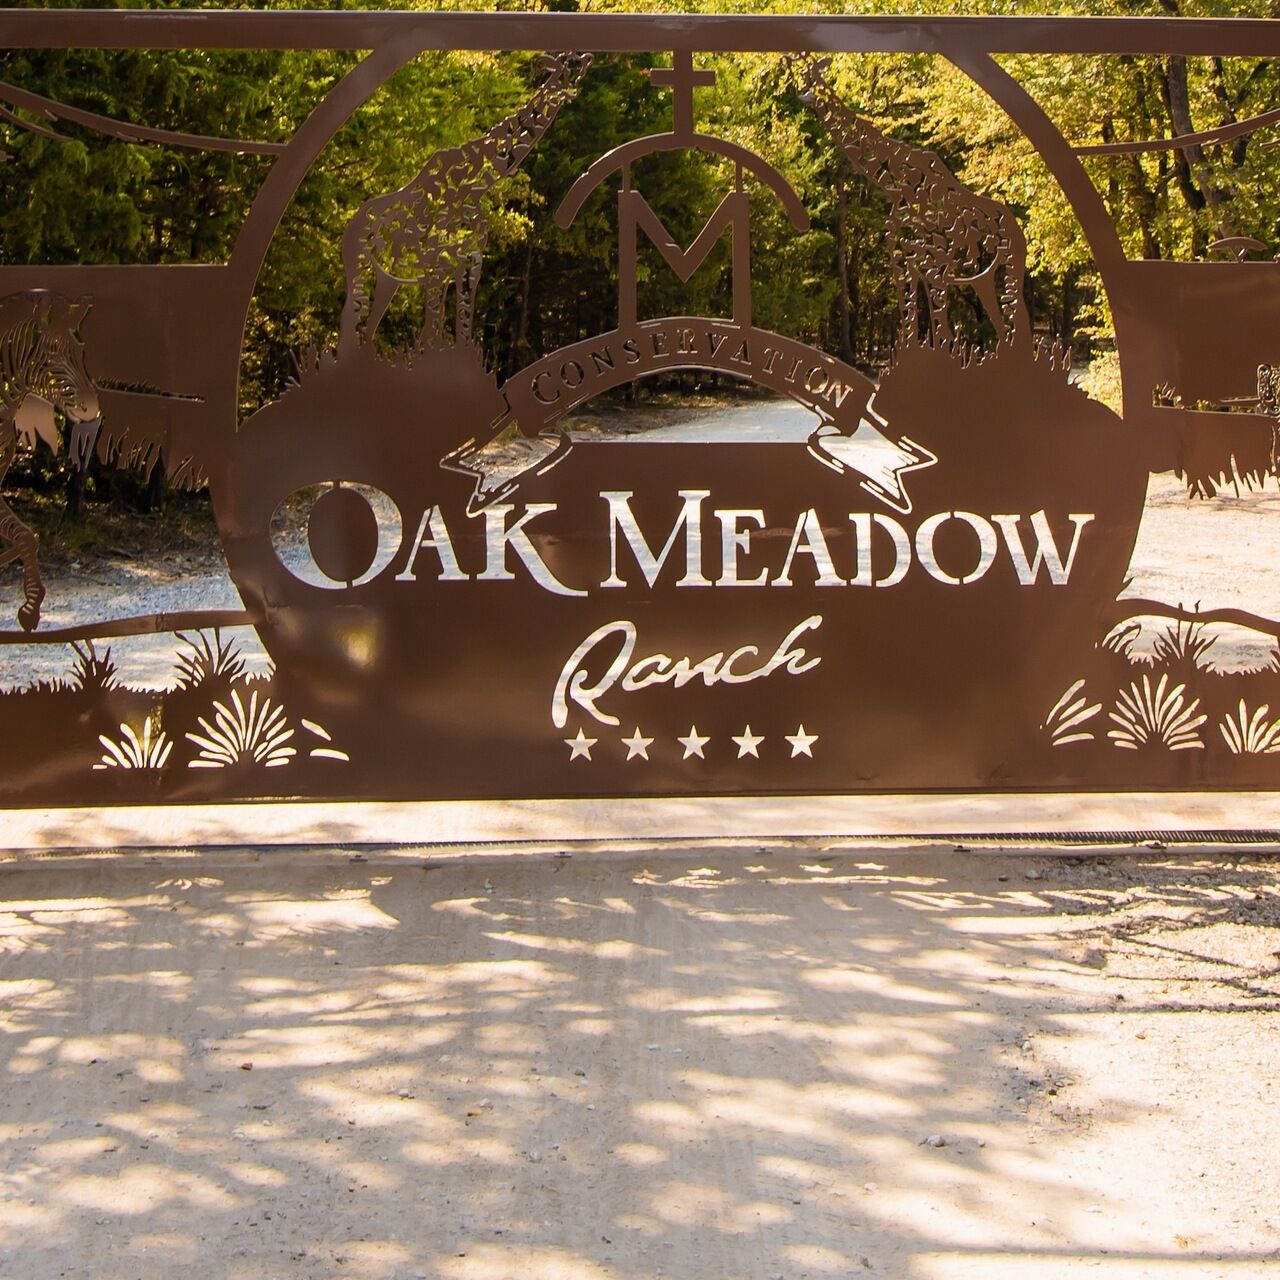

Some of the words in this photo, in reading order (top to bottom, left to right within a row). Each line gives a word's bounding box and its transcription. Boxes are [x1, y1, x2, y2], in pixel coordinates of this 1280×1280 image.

[618, 189, 751, 326] M
[531, 326, 853, 409] CONSERVATION
[269, 480, 589, 597] OAK
[600, 489, 1096, 588] MEADOW
[551, 614, 823, 728] Ranch
